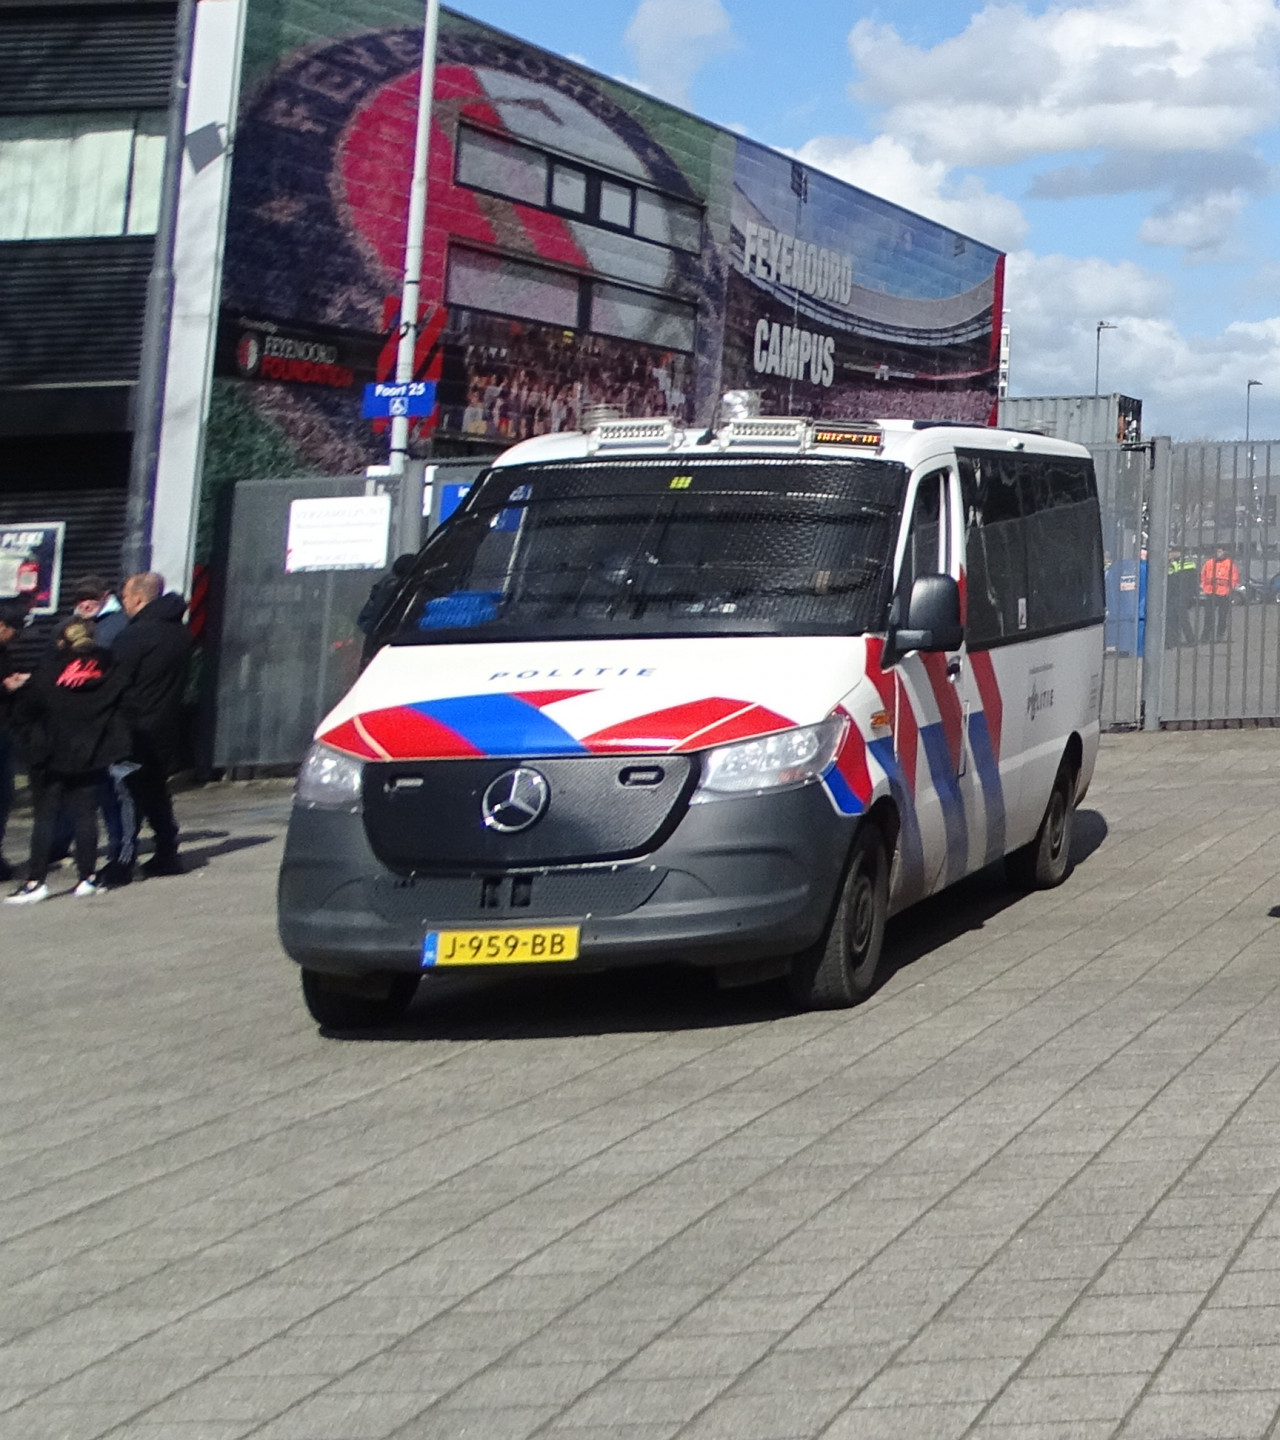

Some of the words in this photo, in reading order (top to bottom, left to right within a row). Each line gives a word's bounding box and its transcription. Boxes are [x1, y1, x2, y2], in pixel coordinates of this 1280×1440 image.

[742, 219, 854, 305] FEYENOORD
[753, 318, 835, 388] CAMPUS
[488, 667, 658, 681] POLITIE
[445, 933, 565, 959] J-959-BB
